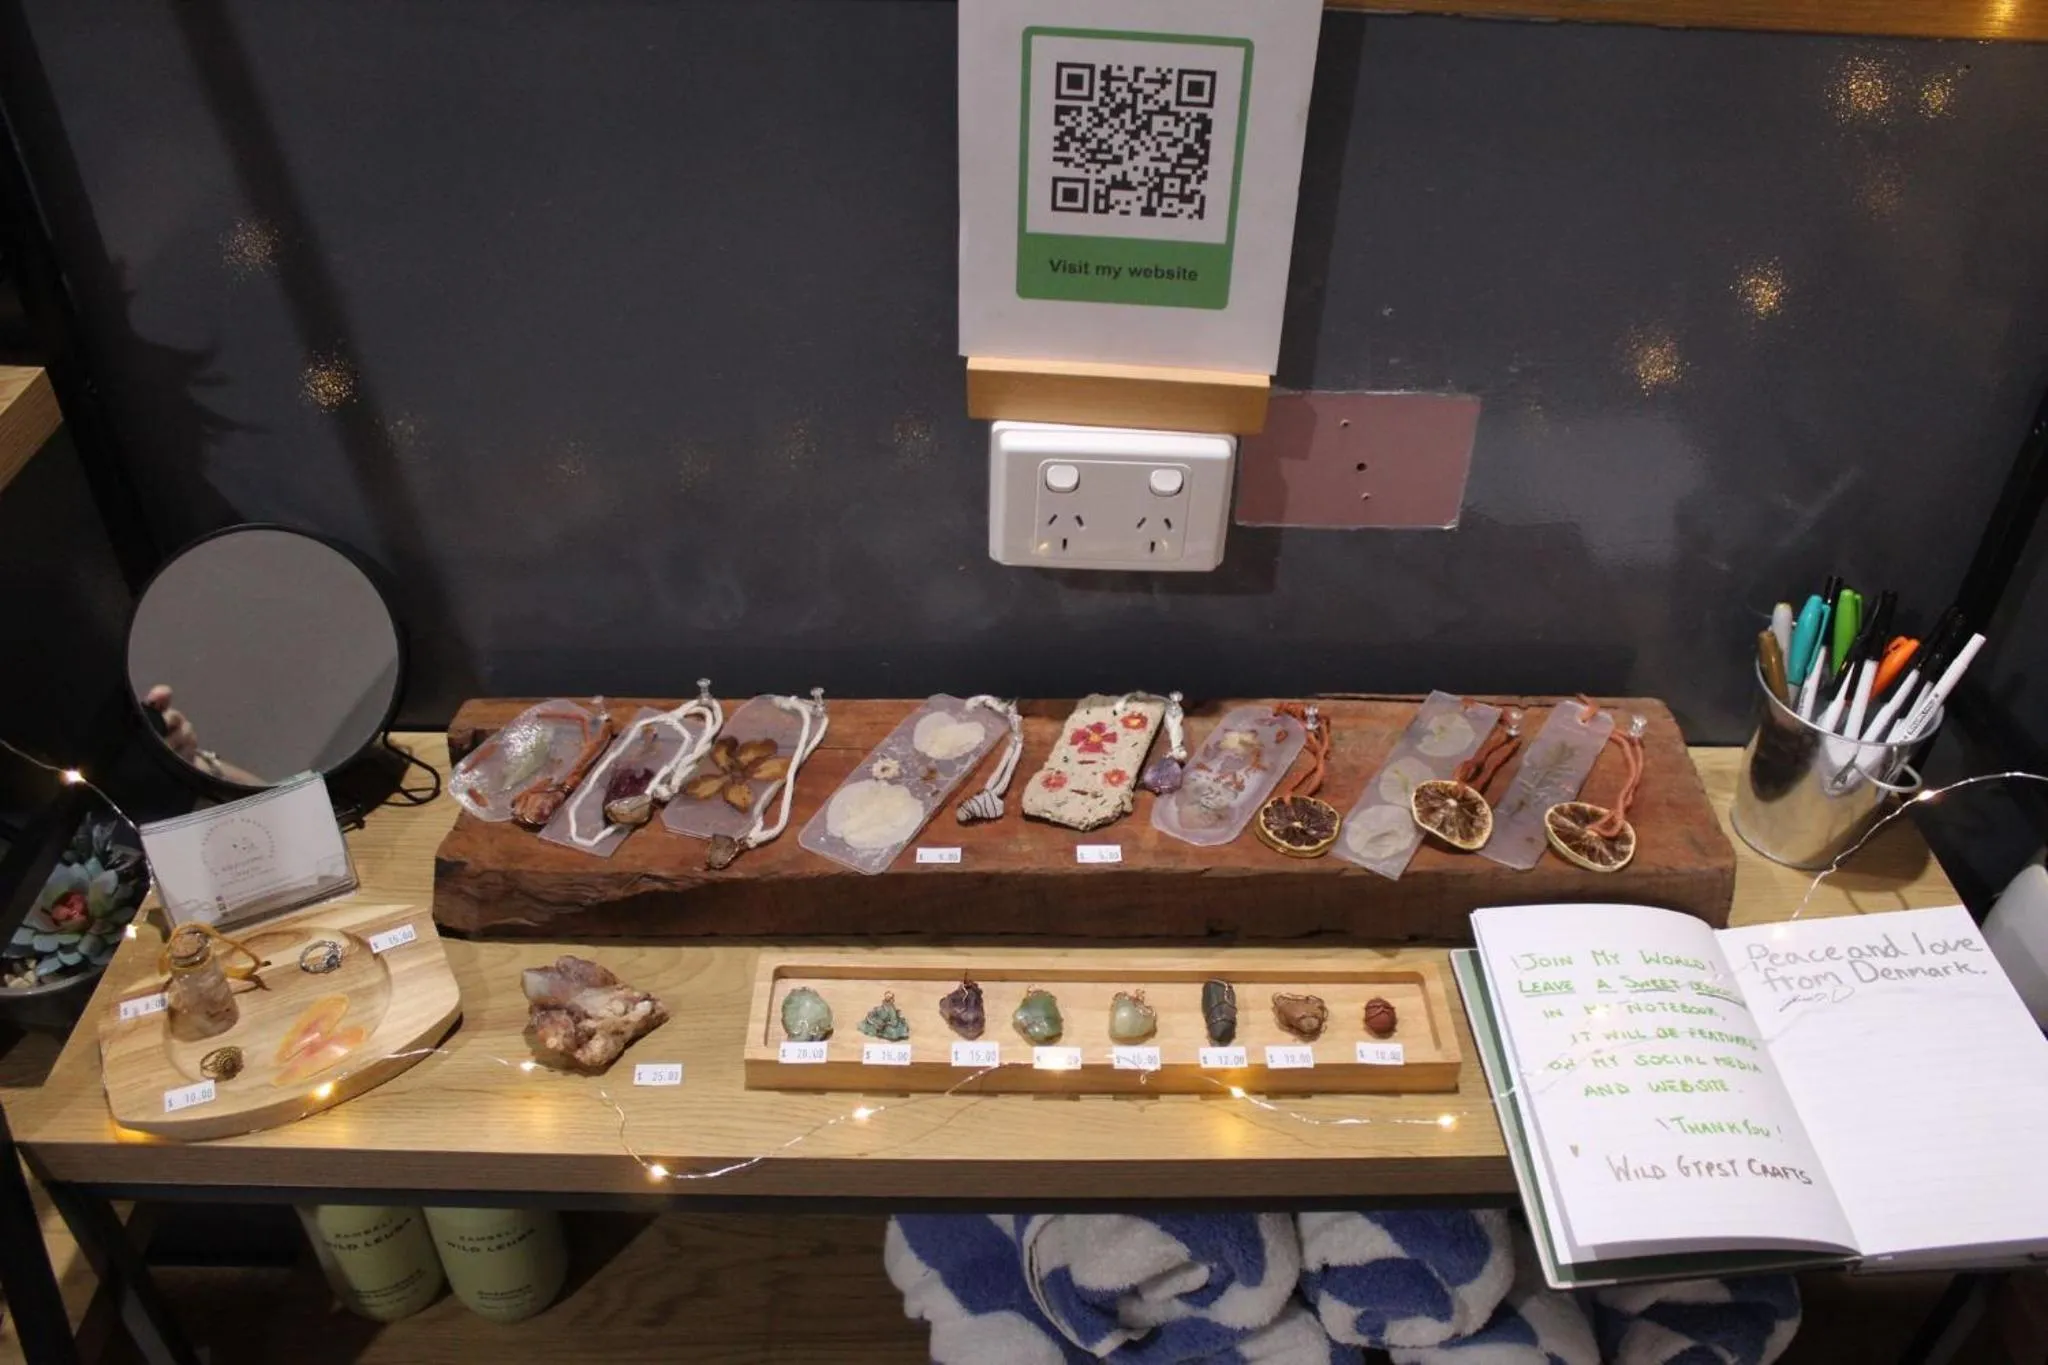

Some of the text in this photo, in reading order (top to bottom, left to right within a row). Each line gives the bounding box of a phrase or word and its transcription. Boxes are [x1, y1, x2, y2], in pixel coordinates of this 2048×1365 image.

[1049, 258, 1198, 282] Visit my website
[1591, 950, 1620, 966] MY
[1746, 932, 1984, 973] Peace and love
[1518, 979, 1573, 993] LEAVE
[1762, 967, 1843, 993] from
[1542, 1007, 1564, 1019] IN
[1570, 1031, 1591, 1046] IT
[1604, 1027, 1647, 1041] WILL
[1592, 1055, 1619, 1068] MY
[1634, 1054, 1708, 1067] SOCIAL
[1714, 1054, 1763, 1073] MEDIA
[185, 1087, 213, 1103] 10.00
[1583, 1082, 1630, 1098] AND
[1605, 1154, 1667, 1182] WILD
[1747, 1157, 1813, 1185] CRAFTS
